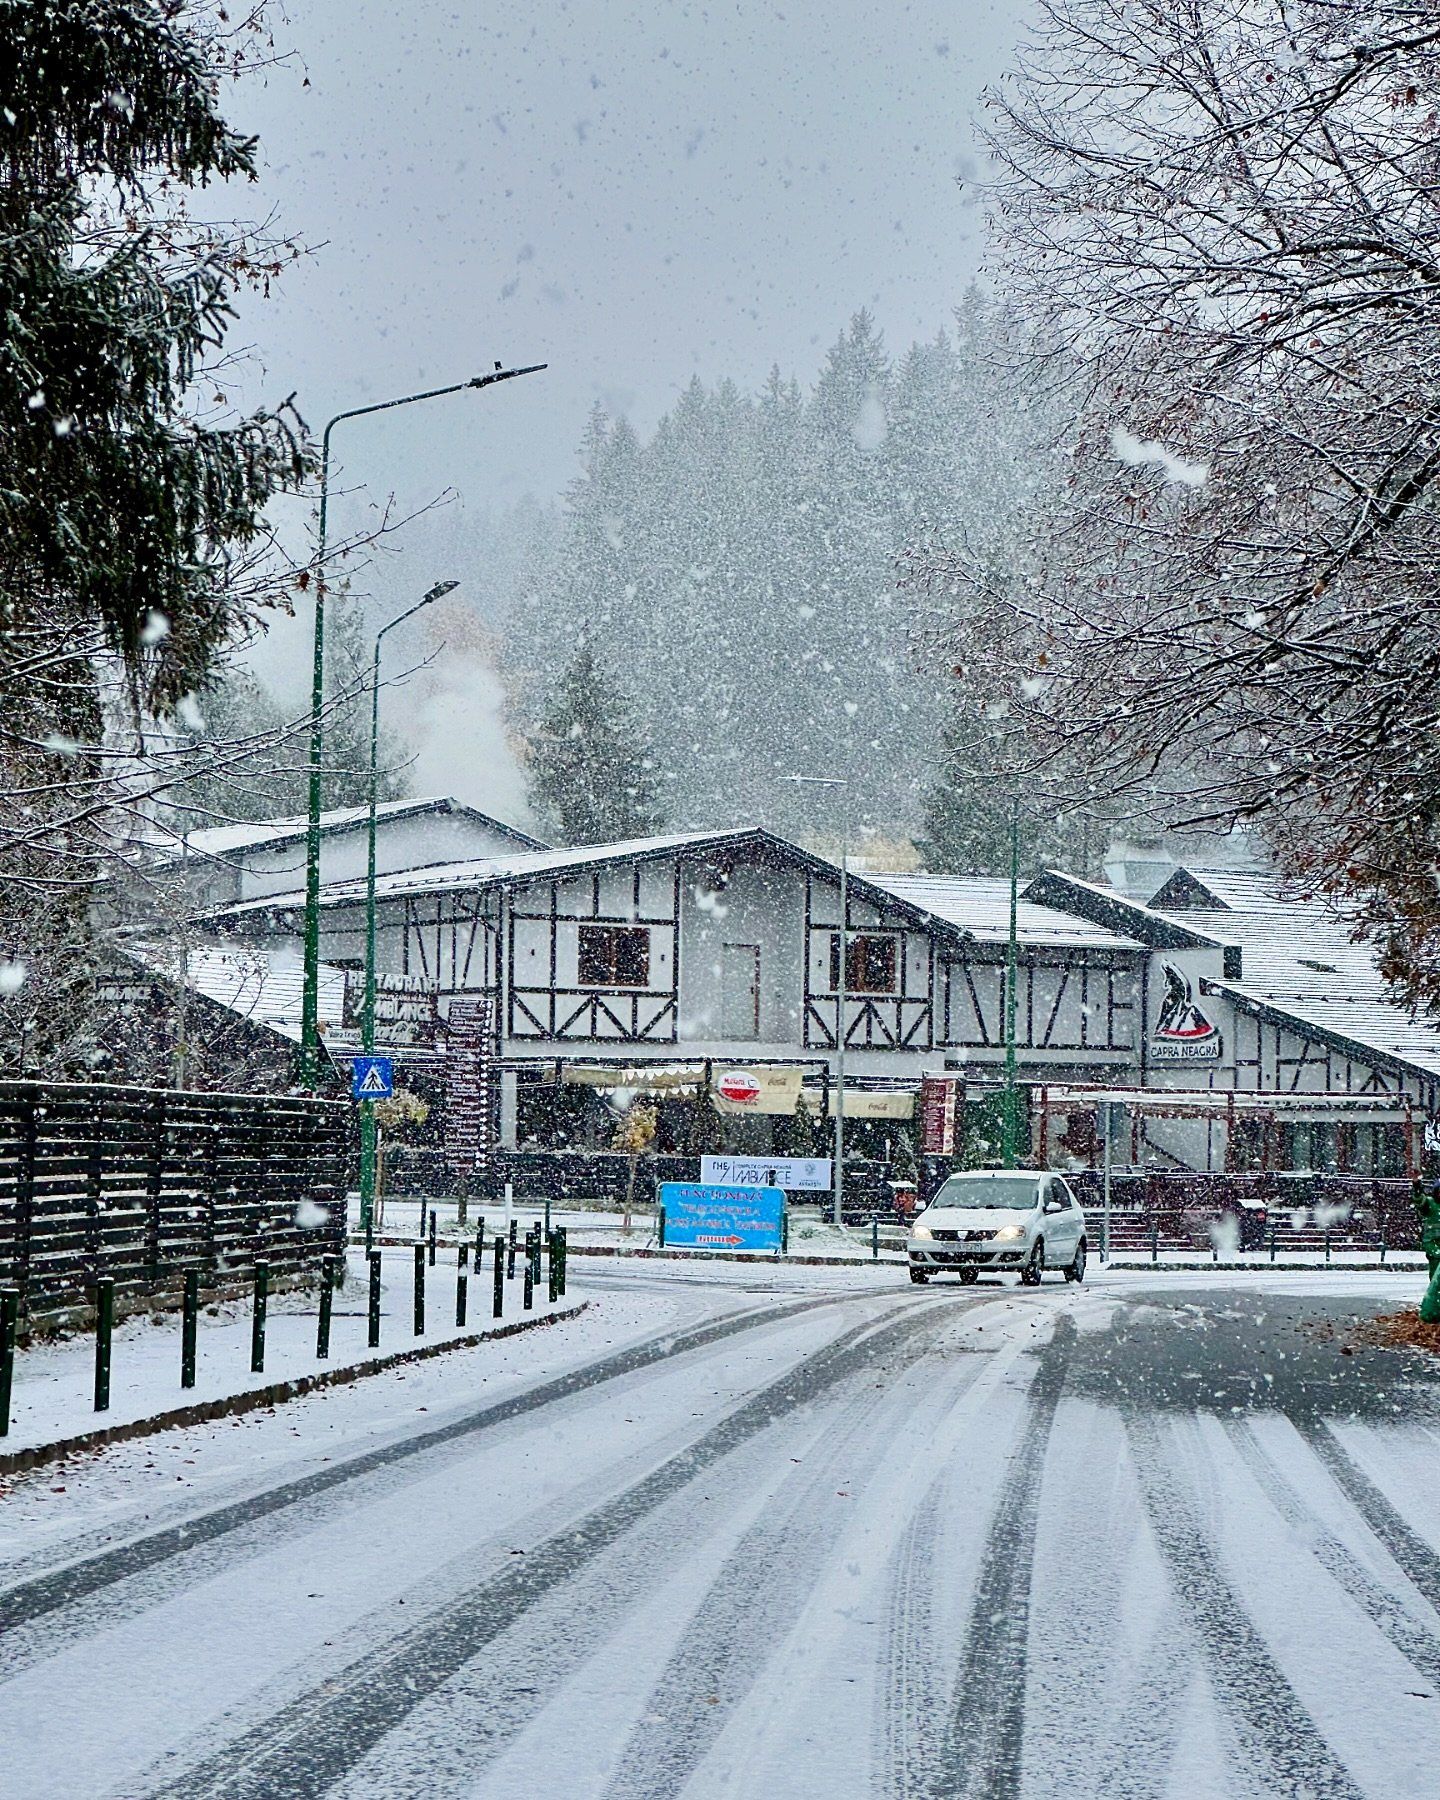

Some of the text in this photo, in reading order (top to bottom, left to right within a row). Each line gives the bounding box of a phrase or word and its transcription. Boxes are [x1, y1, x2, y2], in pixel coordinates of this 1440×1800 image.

[347, 970, 440, 994] RETAURANT
[1151, 1042, 1218, 1057] CAPRA NEAGRĂ
[712, 1161, 728, 1171] THE
[720, 1162, 791, 1185] AMBIACE
